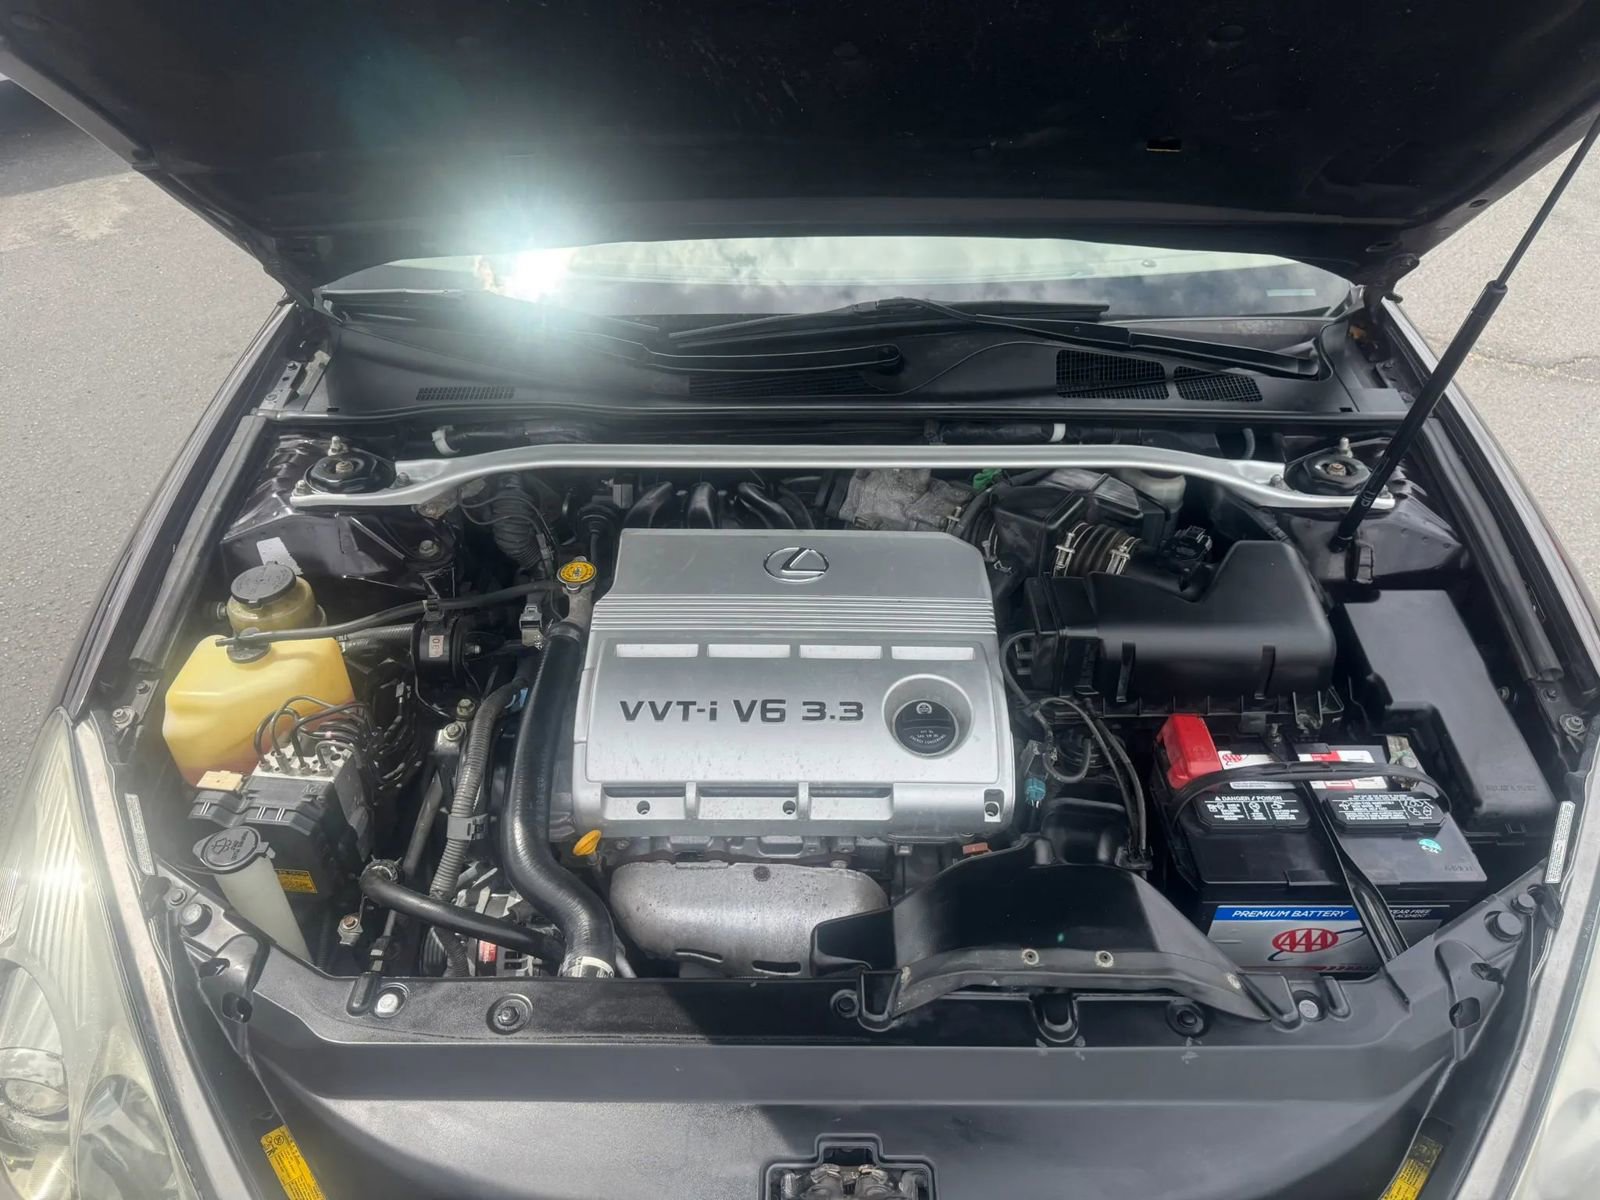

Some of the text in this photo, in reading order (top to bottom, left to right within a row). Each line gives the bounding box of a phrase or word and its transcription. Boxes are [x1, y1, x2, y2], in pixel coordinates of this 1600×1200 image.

[619, 699, 864, 723] VVT-i V6 3.3
[1231, 910, 1349, 918] PREMIUM BATTERY
[1274, 928, 1337, 953] AAA
